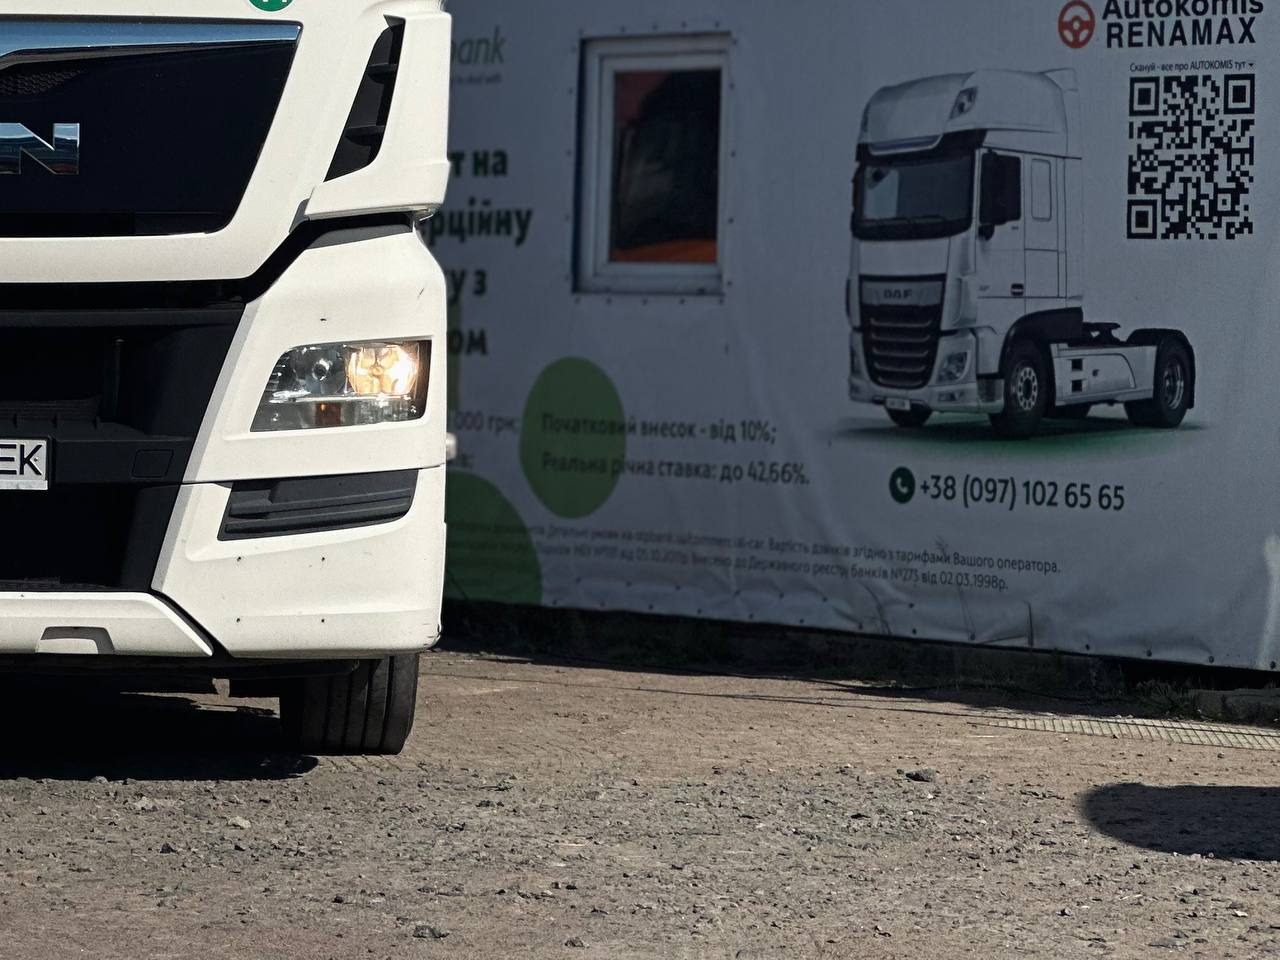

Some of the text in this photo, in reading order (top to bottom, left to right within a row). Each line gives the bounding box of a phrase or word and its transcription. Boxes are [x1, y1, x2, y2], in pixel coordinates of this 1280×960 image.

[1106, 16, 1256, 48] RENAMAX
[472, 149, 508, 176] на
[424, 197, 532, 247] рційну
[640, 419, 696, 439] внесок
[710, 419, 736, 444] від
[719, 462, 743, 483] до
[920, 474, 1126, 511] +38 (097) 102 65 65
[953, 551, 995, 570] Вашого
[996, 557, 1061, 576] оператора.
